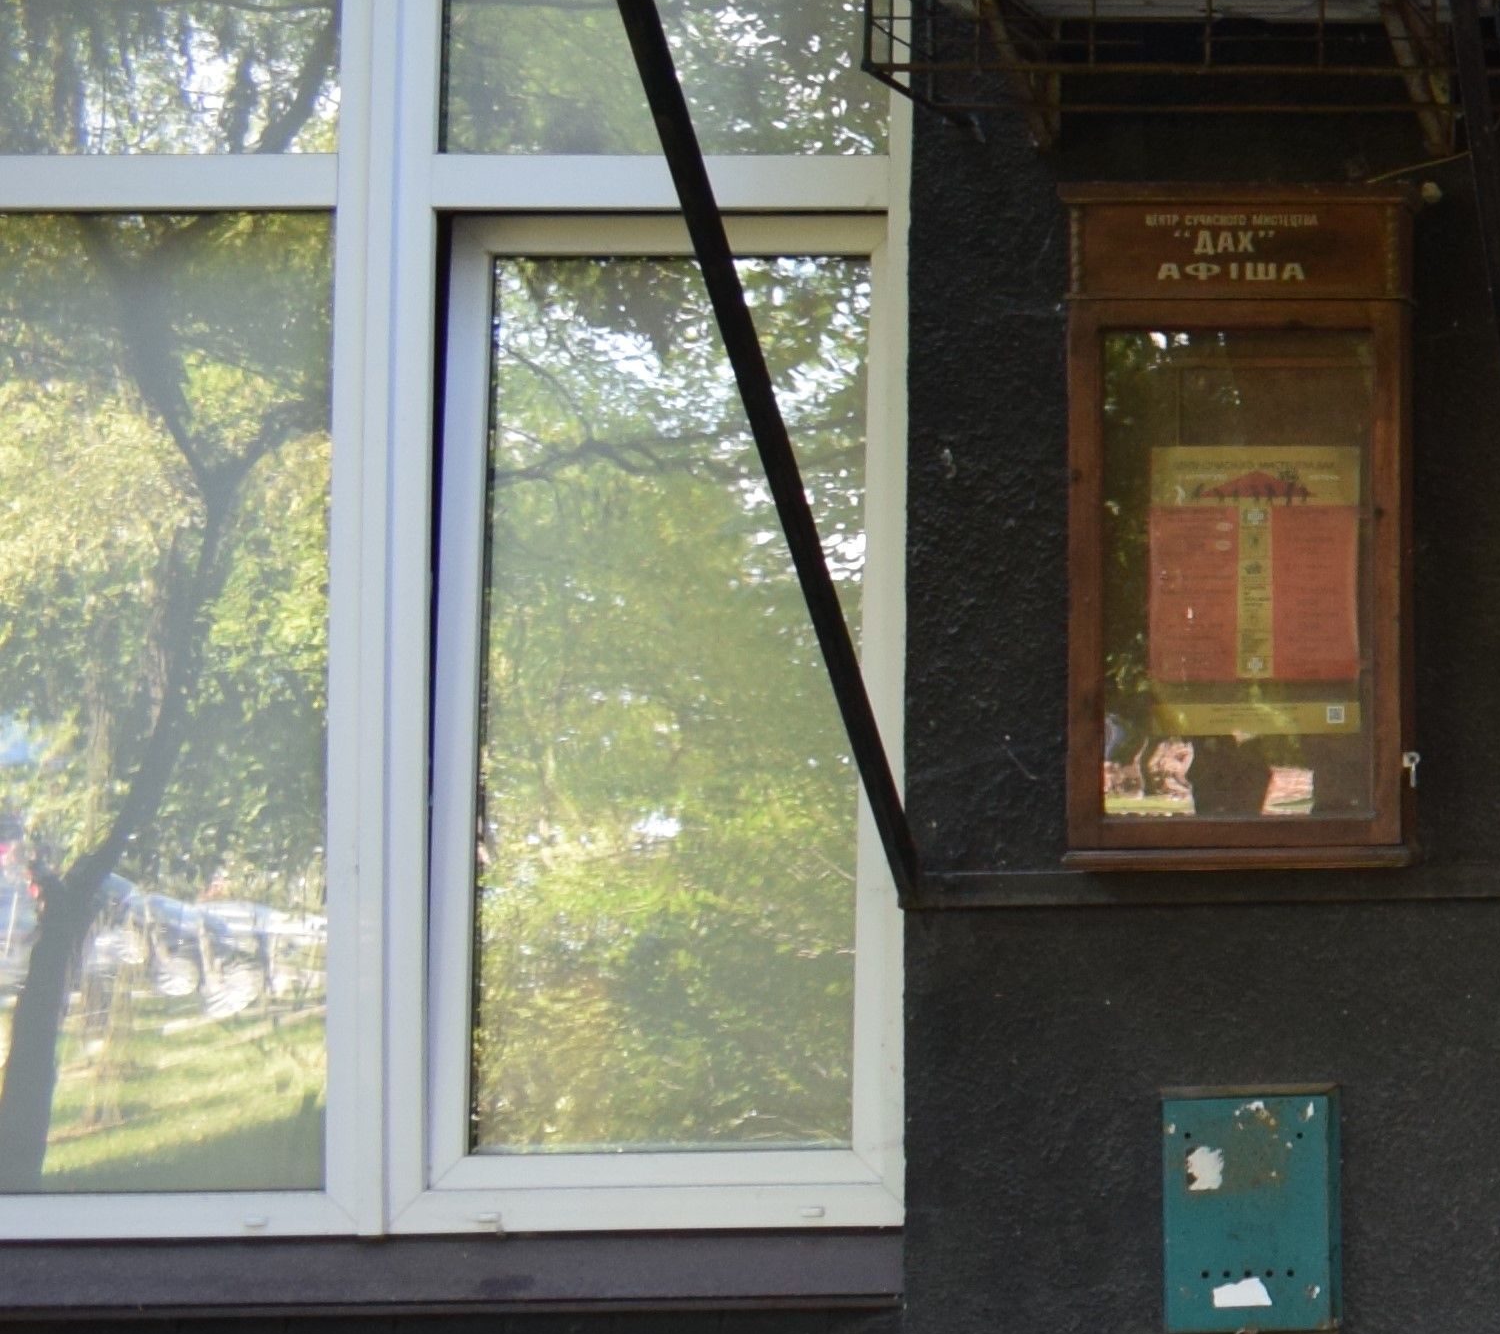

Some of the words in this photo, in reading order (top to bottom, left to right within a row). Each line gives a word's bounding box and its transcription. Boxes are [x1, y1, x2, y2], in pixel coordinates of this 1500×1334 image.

[1145, 214, 1180, 227] ЦЕНТР
[1184, 214, 1248, 226] СУЧАСНОГО
[1252, 214, 1318, 227] МИСТЕЦТВА
[1157, 262, 1305, 281] АФІША
